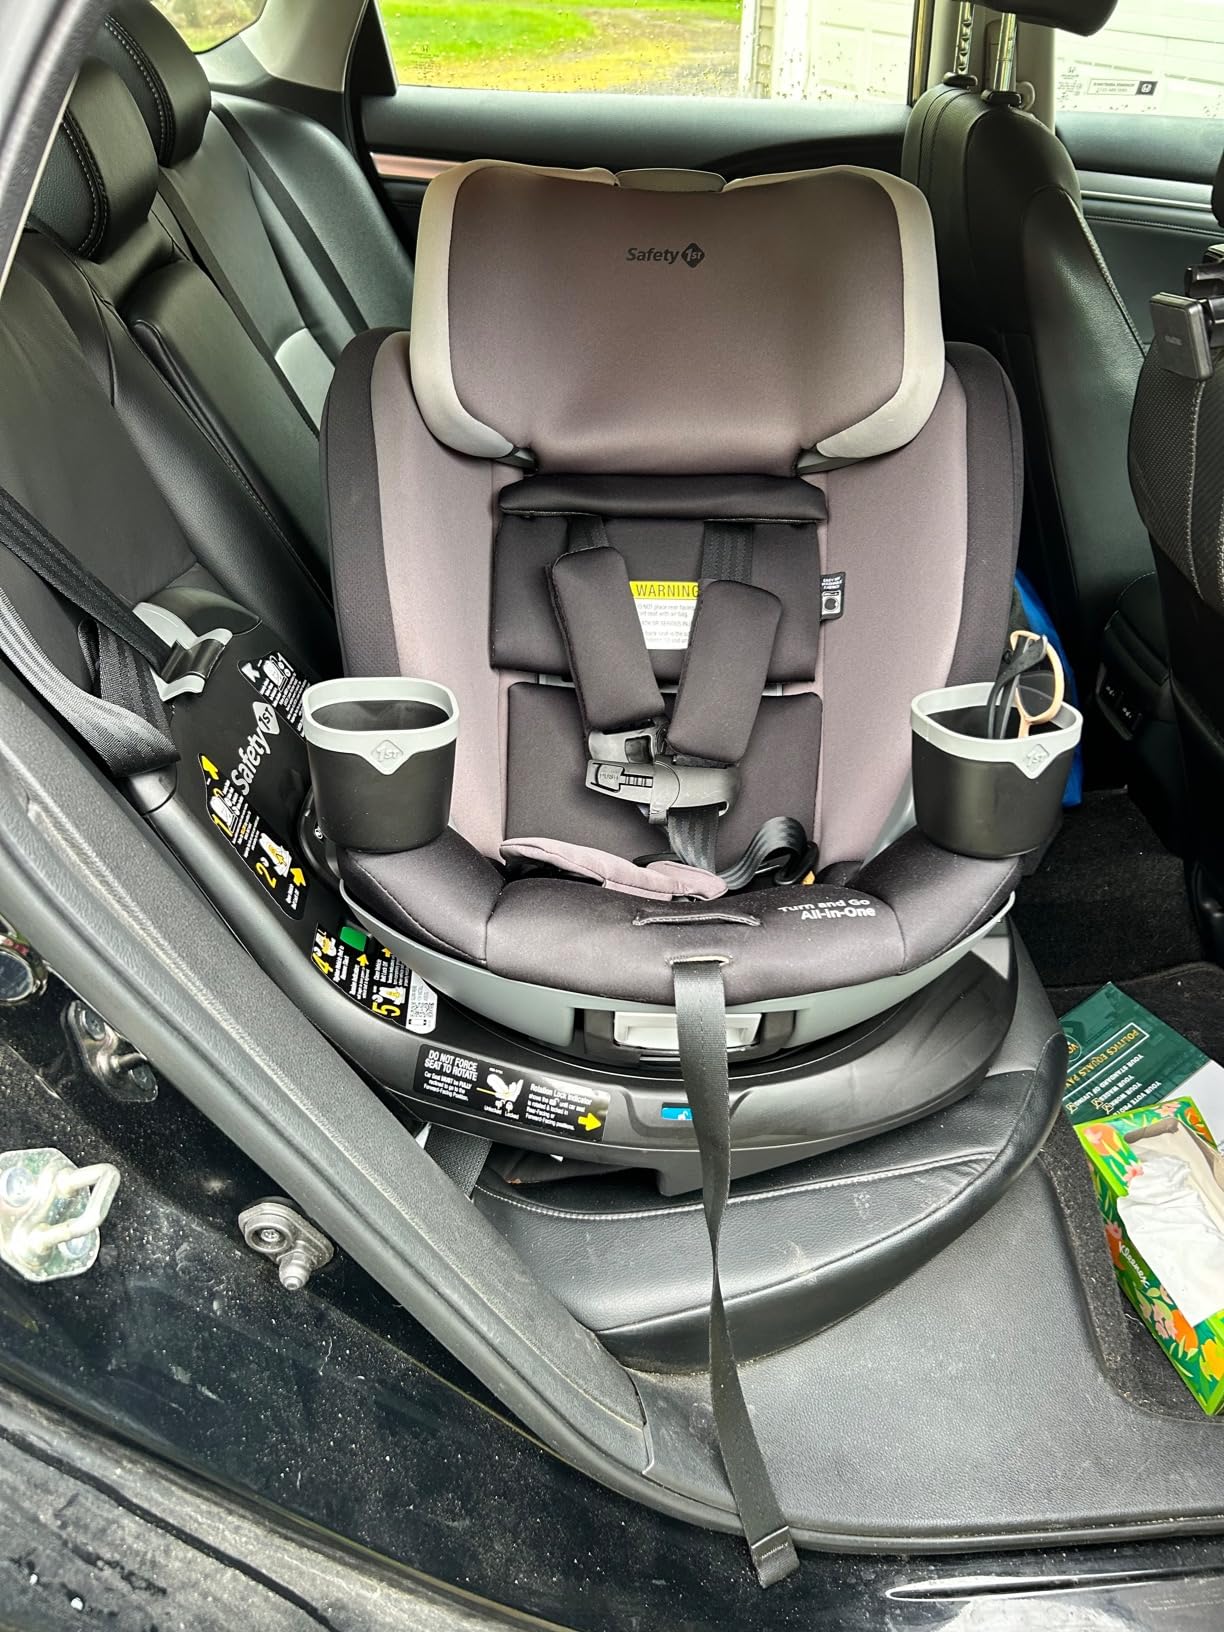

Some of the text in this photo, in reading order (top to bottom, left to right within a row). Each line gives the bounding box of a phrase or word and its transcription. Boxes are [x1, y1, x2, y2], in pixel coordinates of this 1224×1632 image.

[626, 246, 704, 264] Safety 1ST
[636, 584, 700, 598] WARNING
[231, 727, 271, 796] Safety
[256, 705, 276, 732] 1ST
[256, 862, 276, 888] 2
[777, 904, 815, 912] Turn
[817, 900, 846, 908] and
[801, 907, 876, 920] All-In-One
[312, 952, 333, 975] 4
[372, 1001, 400, 1016] 5
[429, 1050, 439, 1060] DO
[440, 1054, 454, 1064] NOT
[455, 1058, 477, 1071] FORCE
[1066, 1030, 1138, 1087] POLITICS EQUALS PAY
[1127, 1055, 1143, 1066] YOUR
[425, 1059, 442, 1070] SEAT
[443, 1064, 452, 1073] TO
[452, 1067, 477, 1080] ROTATE
[1100, 1066, 1128, 1087] STANDARD
[531, 1084, 552, 1095] Rotation
[1100, 1075, 1134, 1101] YOUR WAGES
[1125, 1083, 1141, 1094] YOUR
[1145, 1082, 1161, 1094] YOUR
[1130, 1093, 1146, 1104] VOTE
